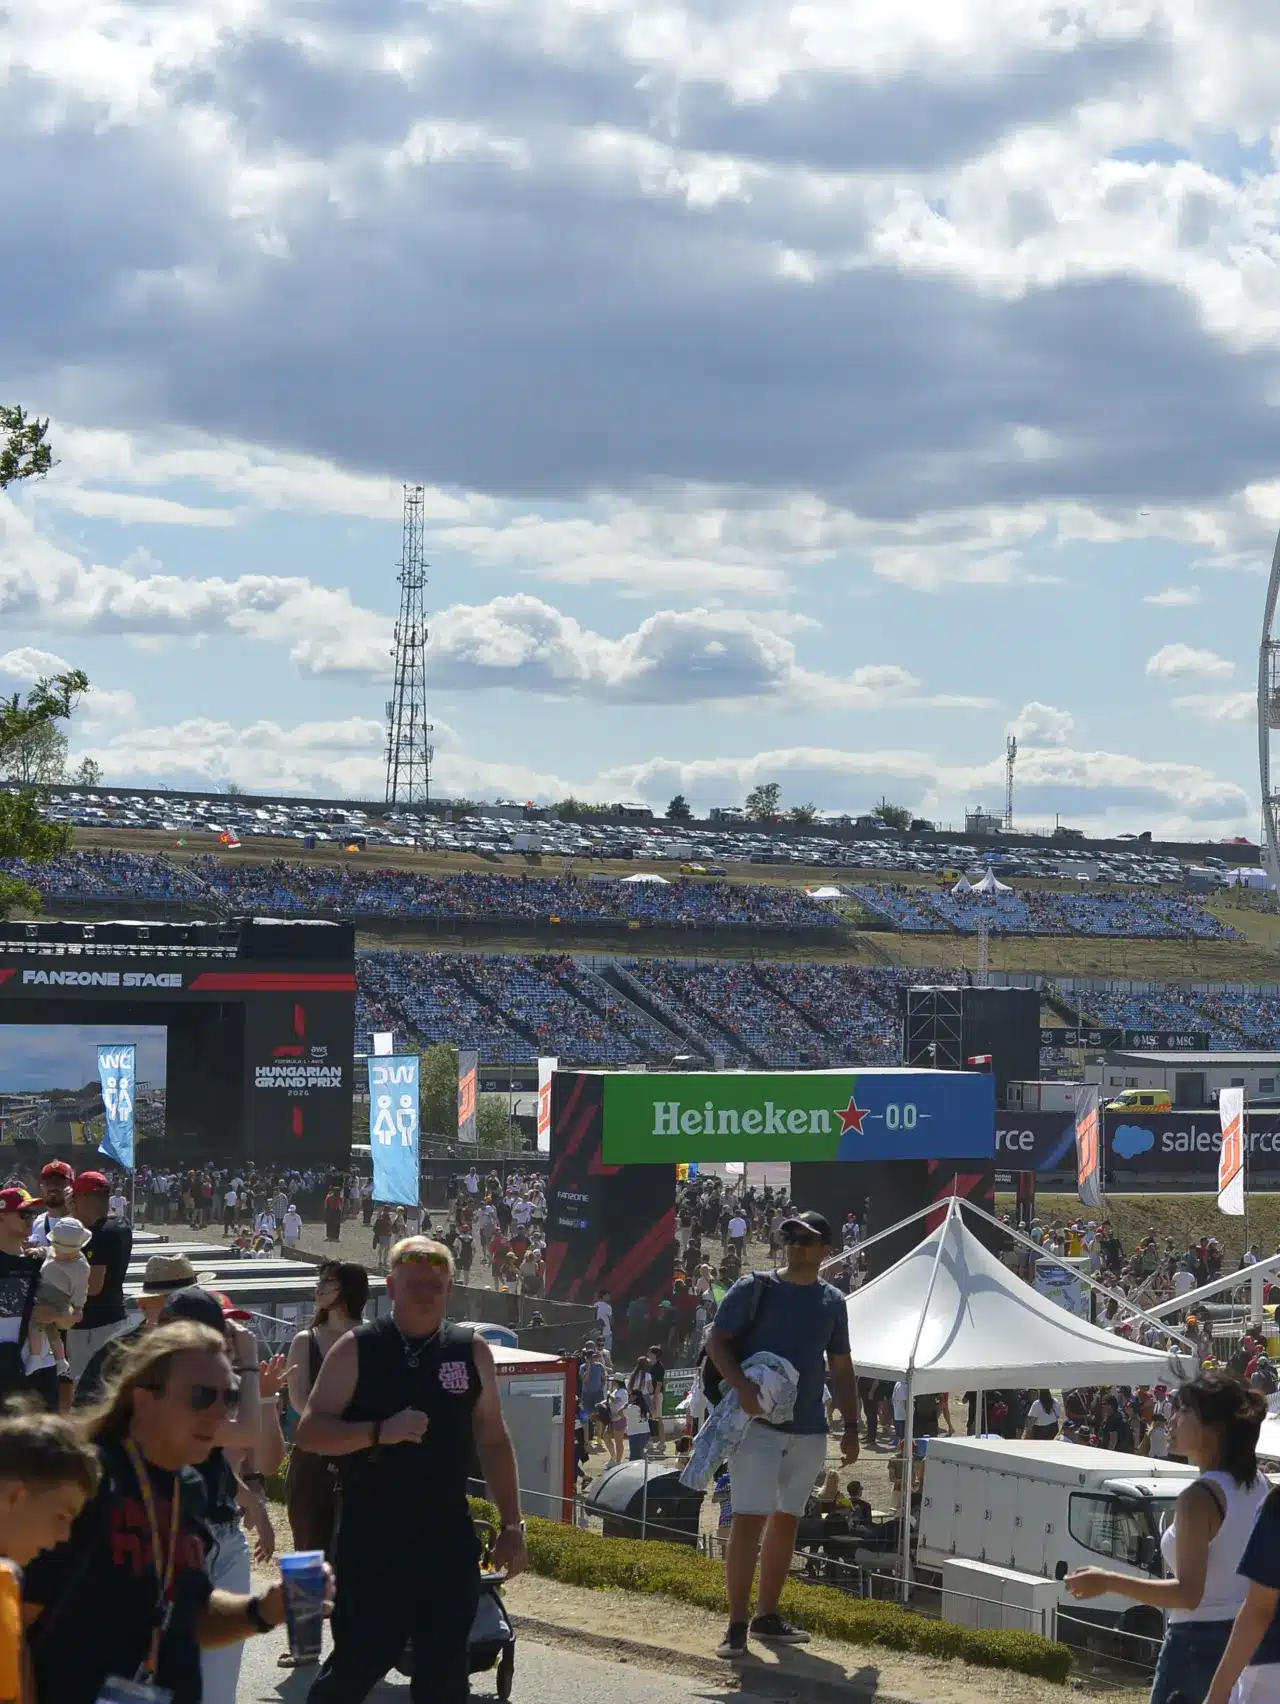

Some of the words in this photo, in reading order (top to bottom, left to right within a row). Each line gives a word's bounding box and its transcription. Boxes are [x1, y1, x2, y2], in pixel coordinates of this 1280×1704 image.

[22, 970, 119, 986] FANZONE
[123, 973, 182, 987] STAGE
[1176, 1036, 1194, 1046] MSC
[100, 1054, 131, 1069] WC
[255, 1066, 342, 1077] HUNGARIAN
[255, 1077, 306, 1088] GRAND
[307, 1077, 342, 1088] PRIX
[652, 1101, 832, 1135] Heineken
